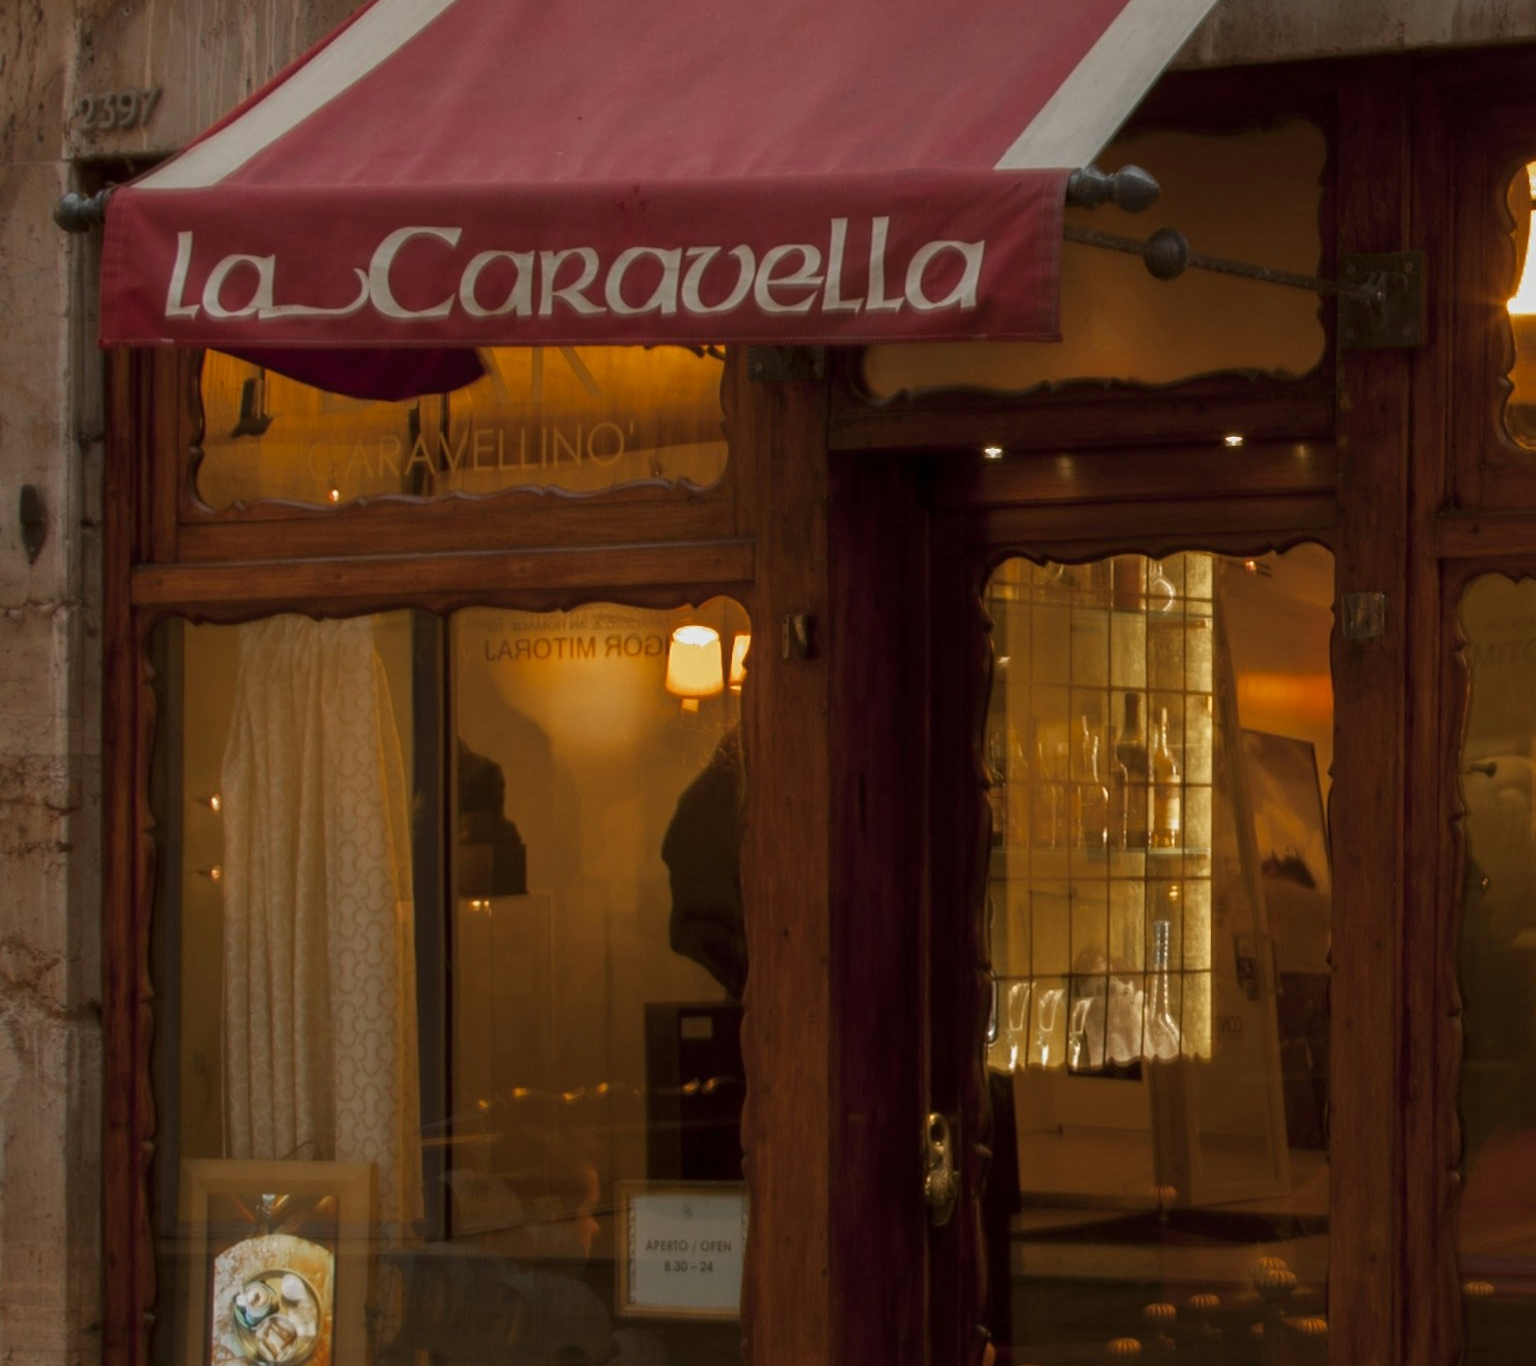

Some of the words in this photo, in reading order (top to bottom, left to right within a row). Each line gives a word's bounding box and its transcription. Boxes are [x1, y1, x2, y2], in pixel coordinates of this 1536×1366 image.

[78, 86, 163, 132] 2397
[366, 215, 987, 321] Caravella
[645, 1239, 688, 1252] APERTO
[700, 1240, 732, 1252] OPEN
